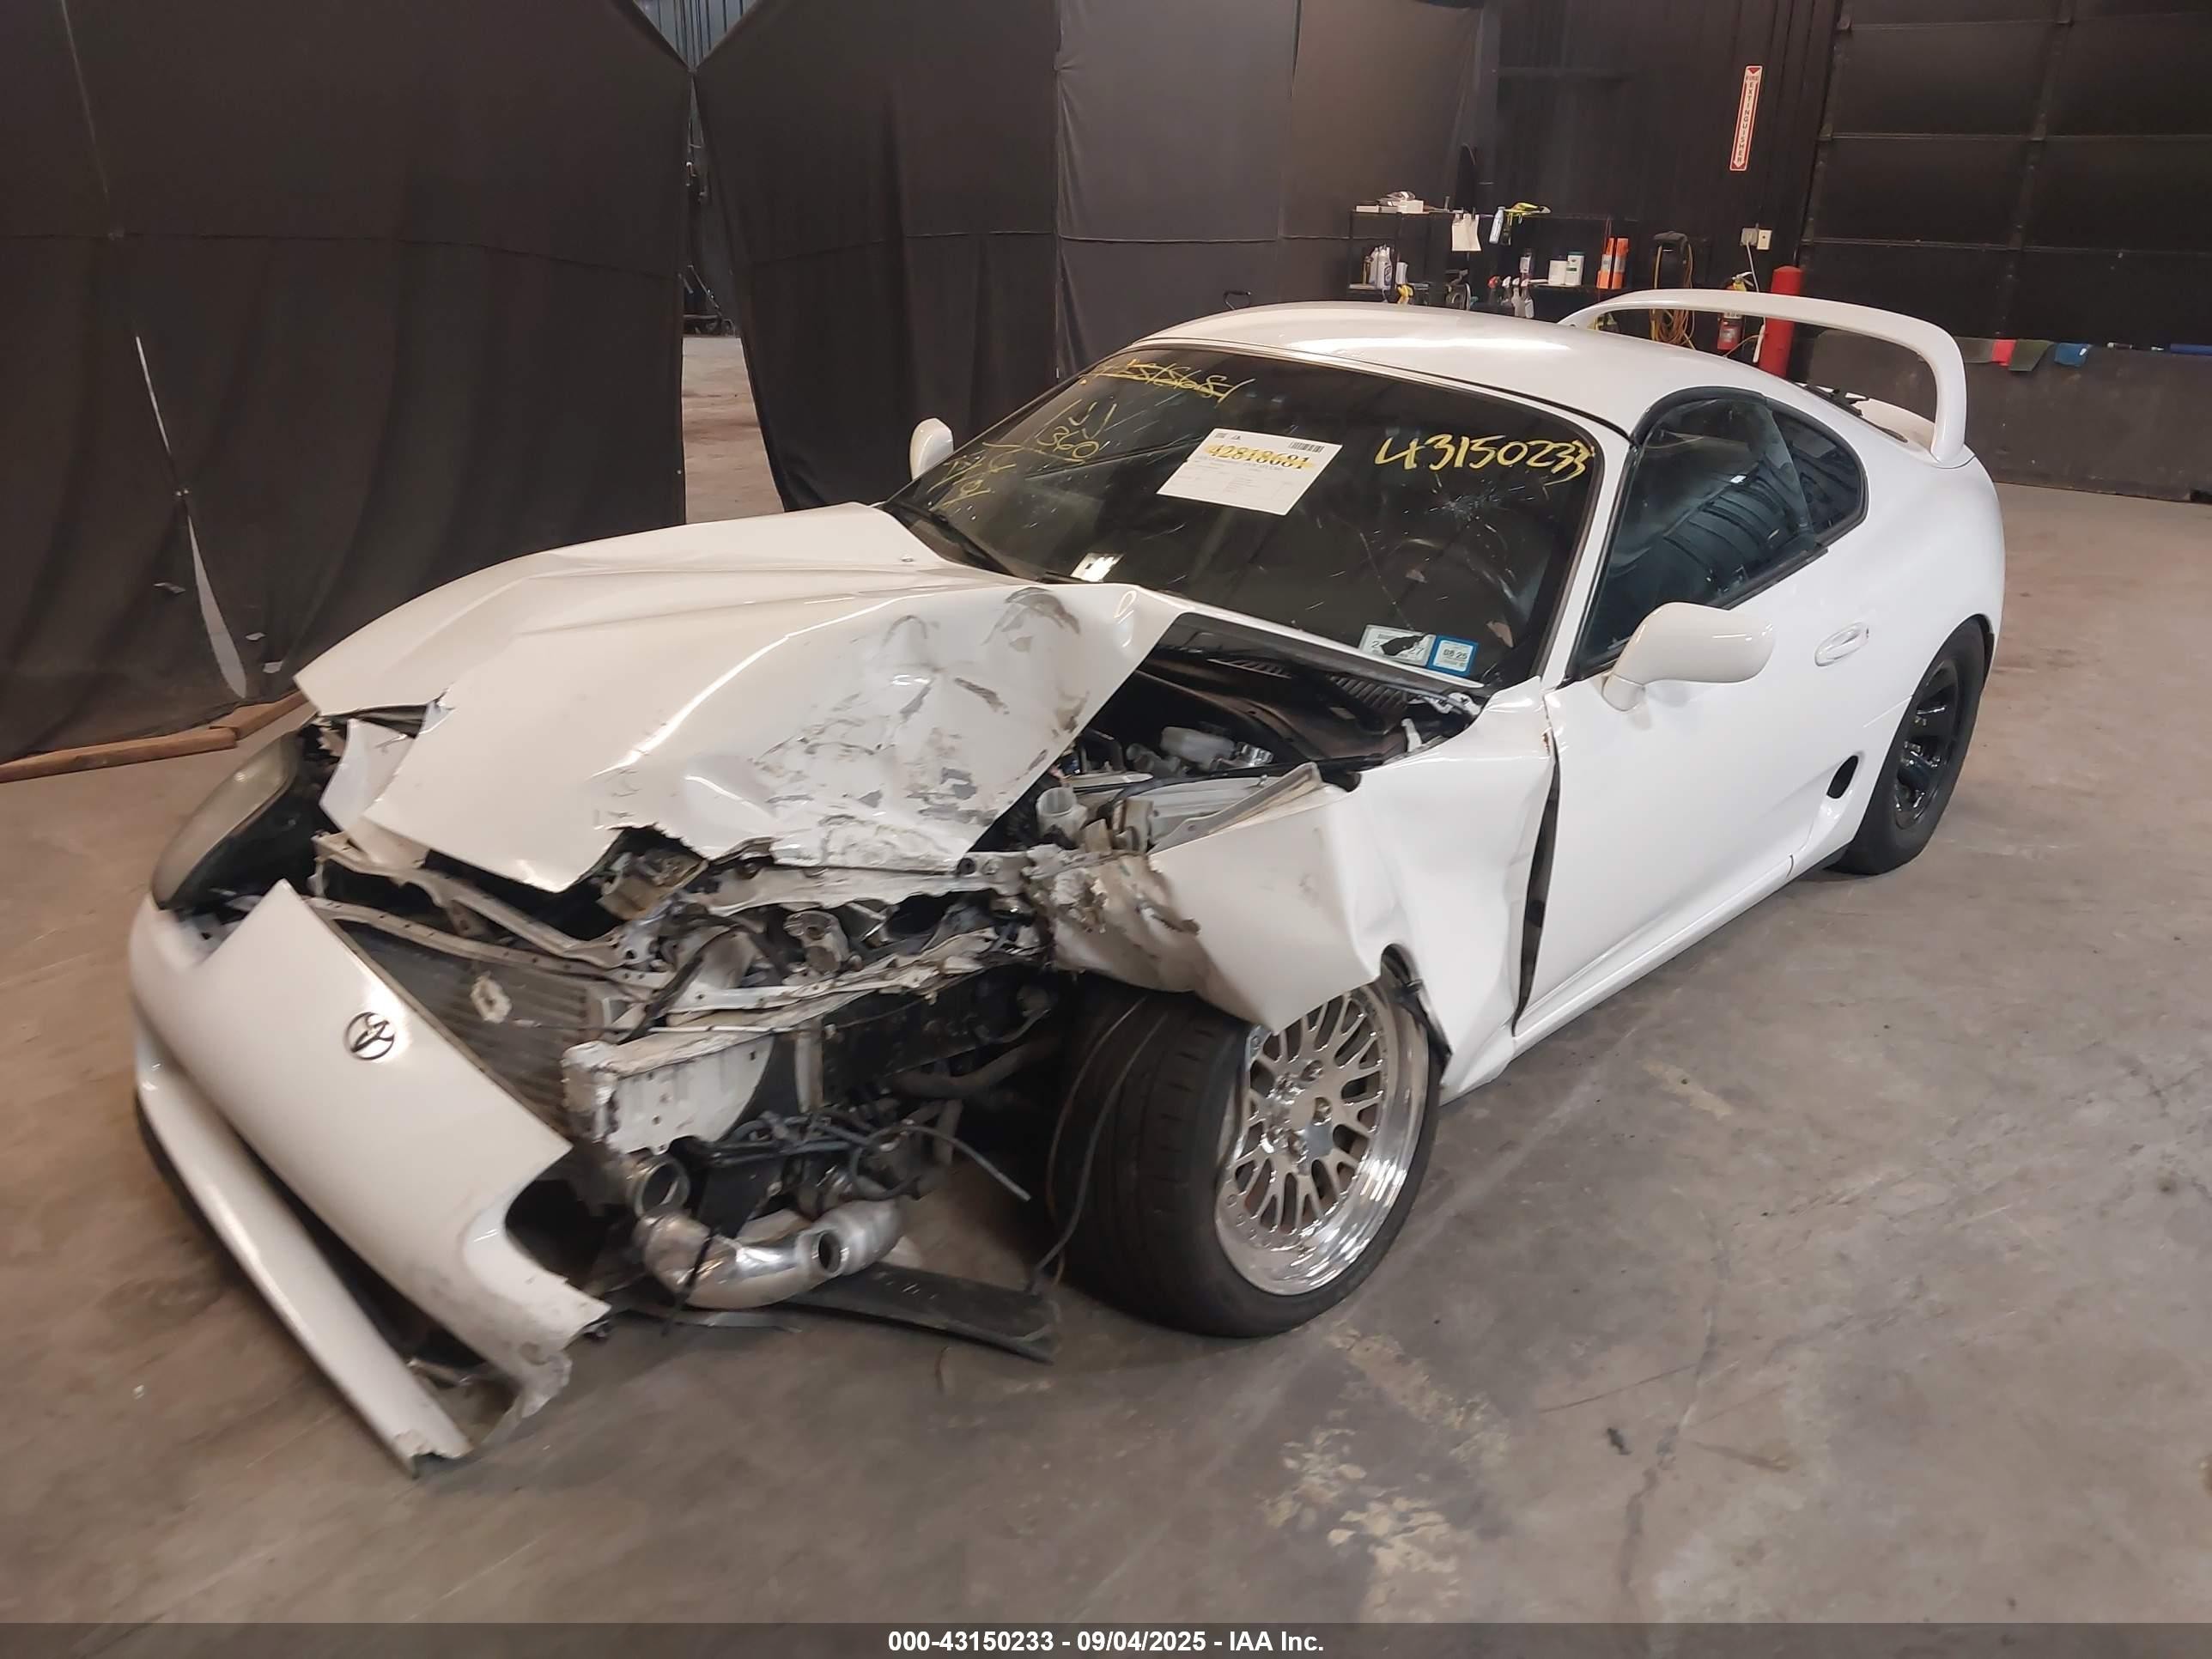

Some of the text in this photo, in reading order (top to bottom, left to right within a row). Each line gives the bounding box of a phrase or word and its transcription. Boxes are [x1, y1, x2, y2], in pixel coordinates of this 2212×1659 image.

[1736, 82, 1753, 164] EXTINGUISHER
[1036, 425, 1100, 459] 360
[1208, 444, 1310, 470] 42818681
[1374, 433, 1595, 487] 43150233
